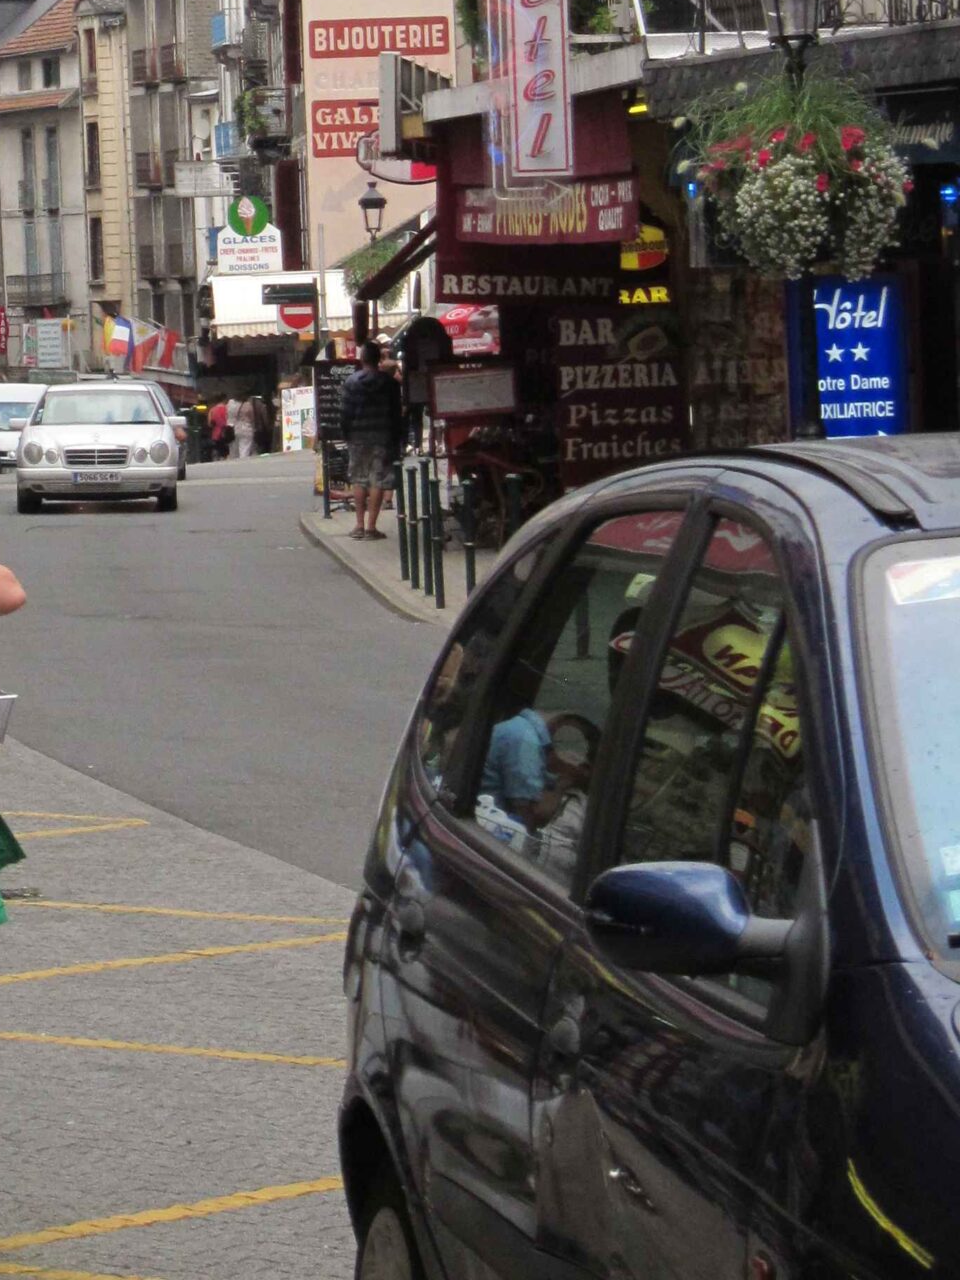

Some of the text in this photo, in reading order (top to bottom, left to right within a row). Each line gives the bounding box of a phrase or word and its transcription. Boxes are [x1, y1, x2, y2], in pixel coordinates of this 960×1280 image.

[314, 24, 444, 51] BIJOUTERIE
[222, 235, 276, 244] GLACES
[229, 263, 269, 271] BOISSONS
[442, 273, 613, 296] RESTAURANT
[814, 286, 888, 329] Hôtel
[559, 319, 617, 346] BAR
[560, 363, 678, 391] PIZZERIA
[851, 375, 889, 391] Dame
[566, 403, 674, 427] Pizzas
[565, 432, 681, 462] Fraiches
